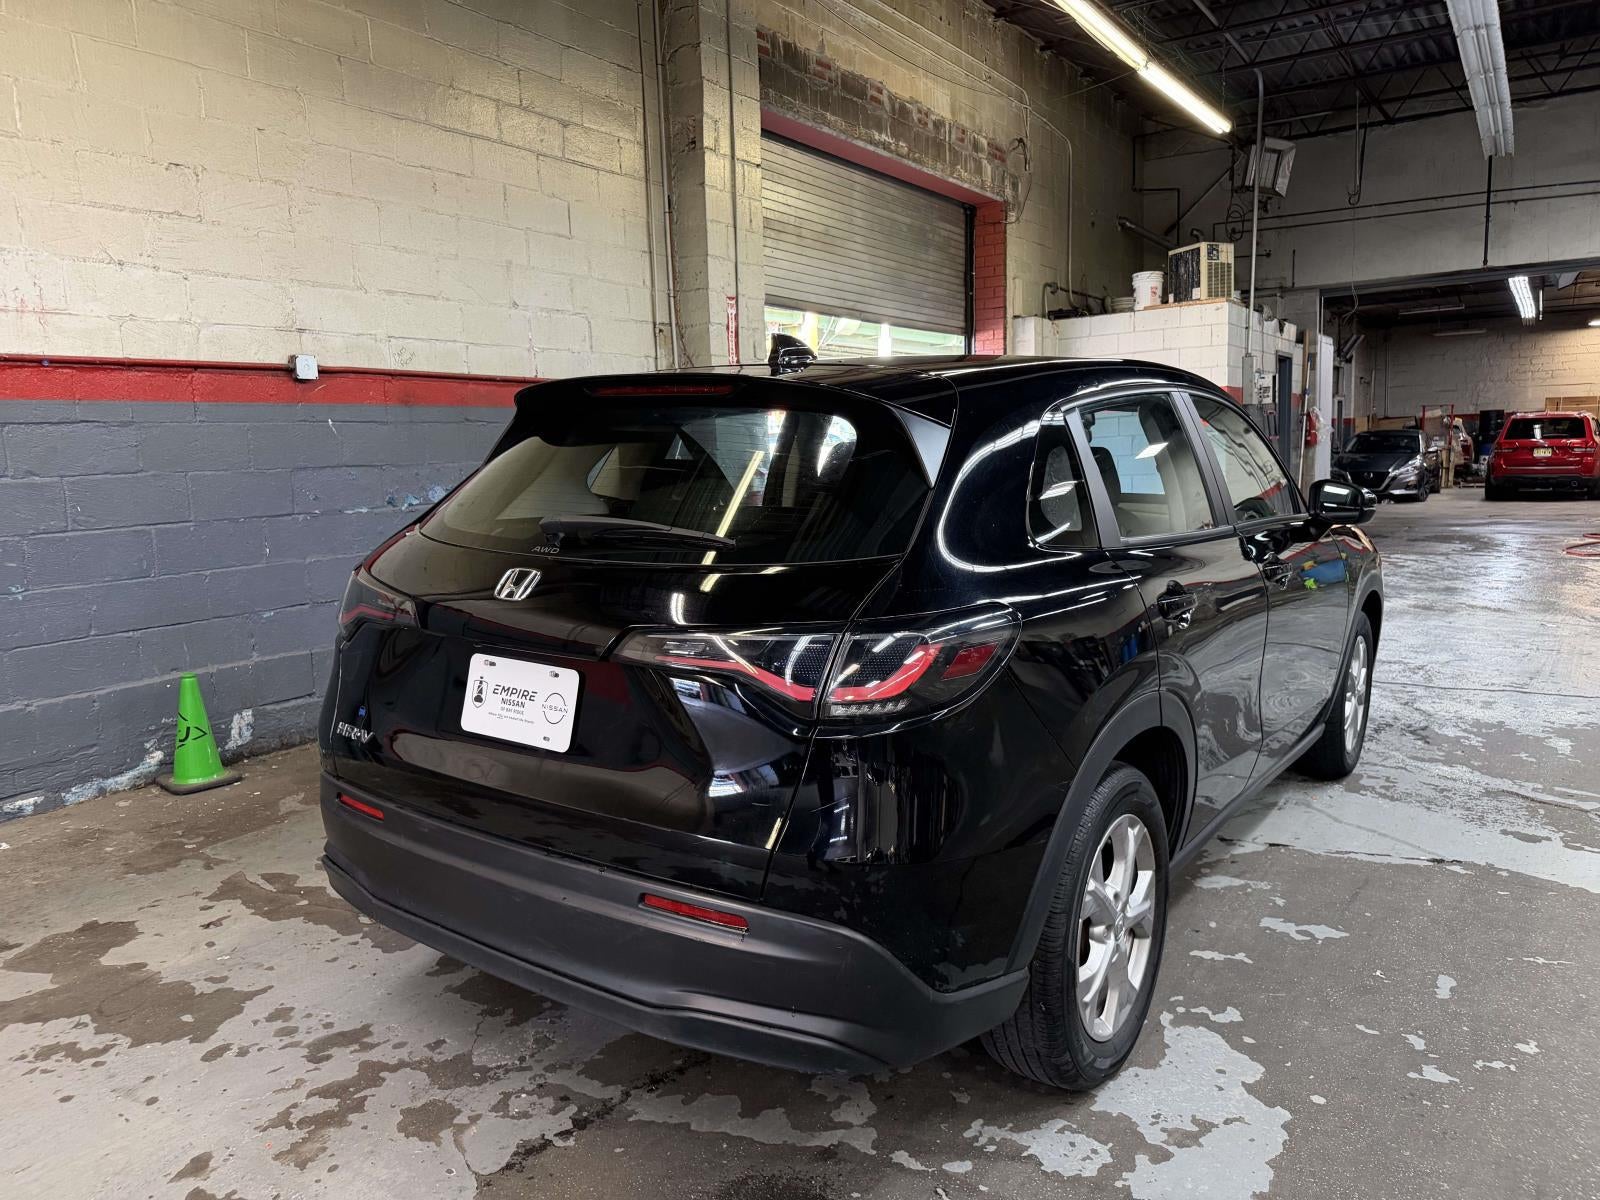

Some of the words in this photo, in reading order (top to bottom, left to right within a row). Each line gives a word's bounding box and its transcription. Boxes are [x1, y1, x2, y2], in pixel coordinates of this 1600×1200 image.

[531, 546, 560, 554] AWD
[492, 684, 538, 702] EMPIRE
[500, 697, 526, 709] NISSAN
[541, 703, 569, 714] NISSAN
